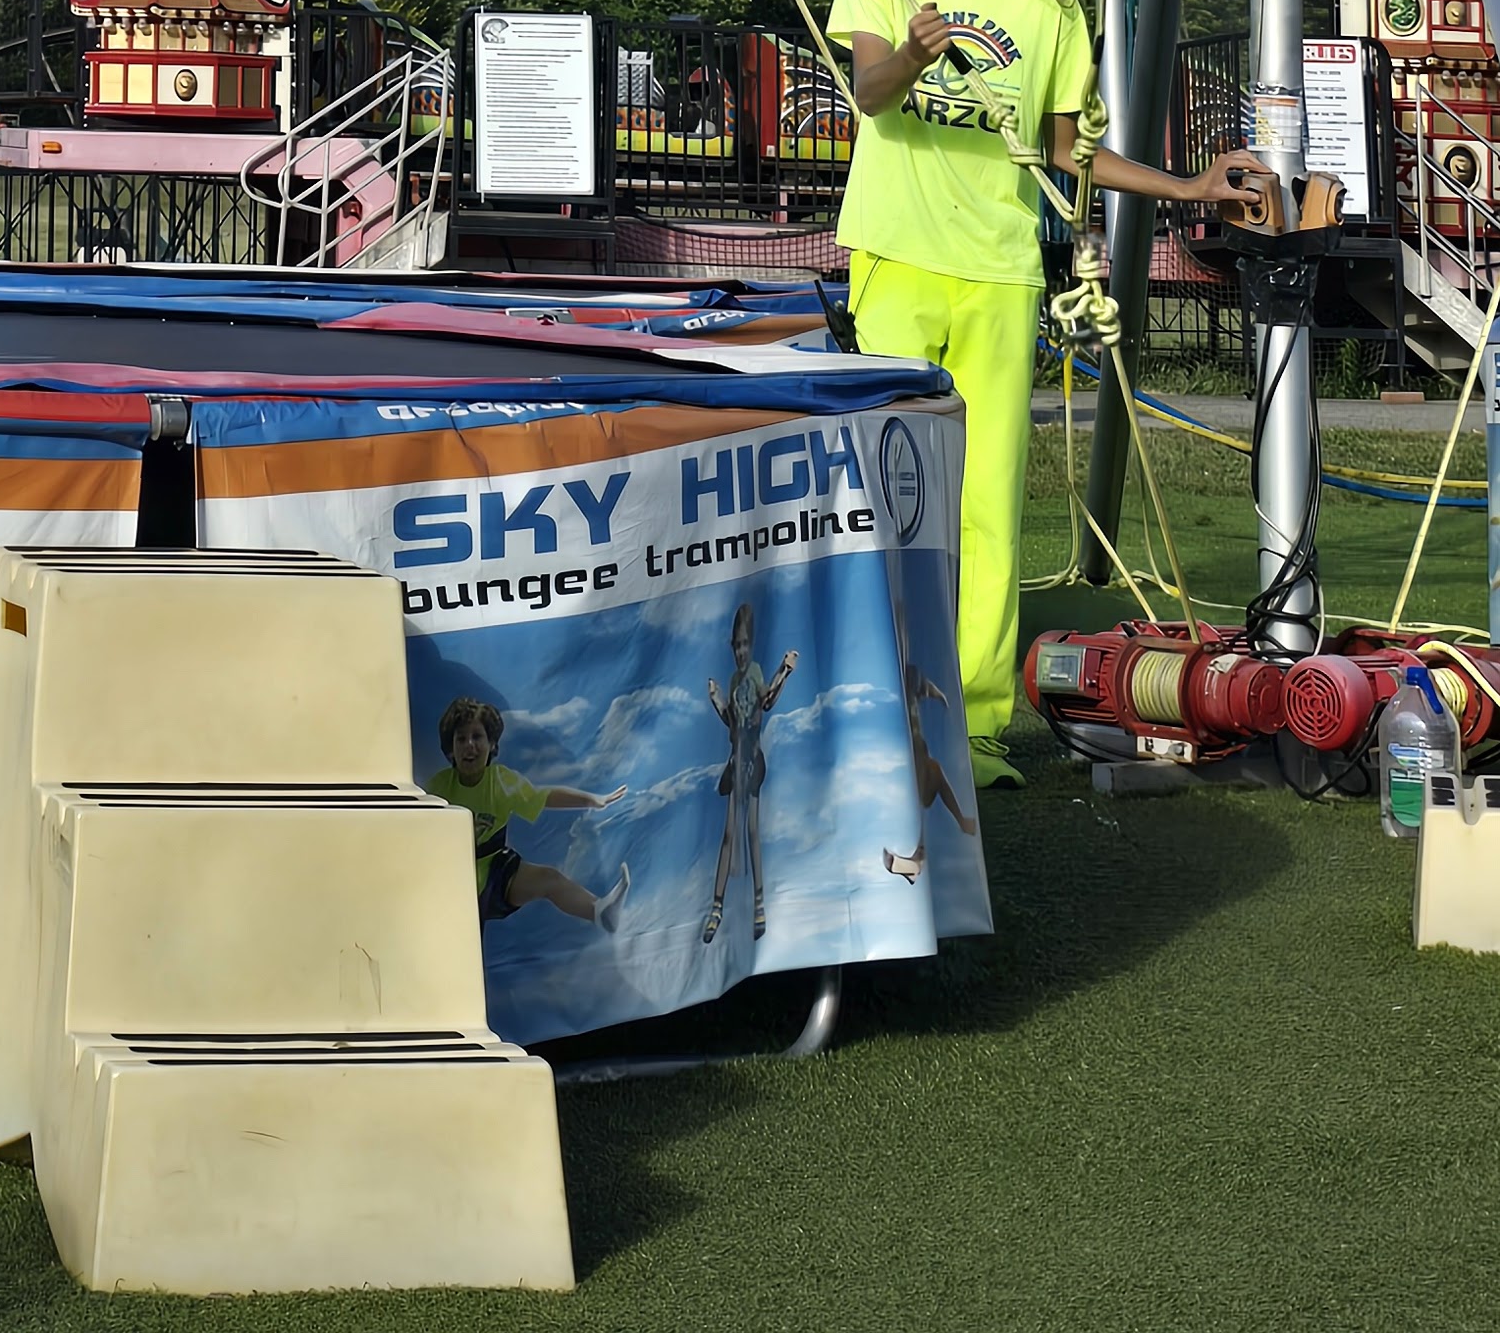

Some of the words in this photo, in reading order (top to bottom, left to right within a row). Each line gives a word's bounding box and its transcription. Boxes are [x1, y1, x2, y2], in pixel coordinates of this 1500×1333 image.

[392, 470, 633, 570] SKY
[681, 425, 866, 527] HIGH
[402, 562, 620, 616] bungee
[644, 507, 877, 578] trampoline
